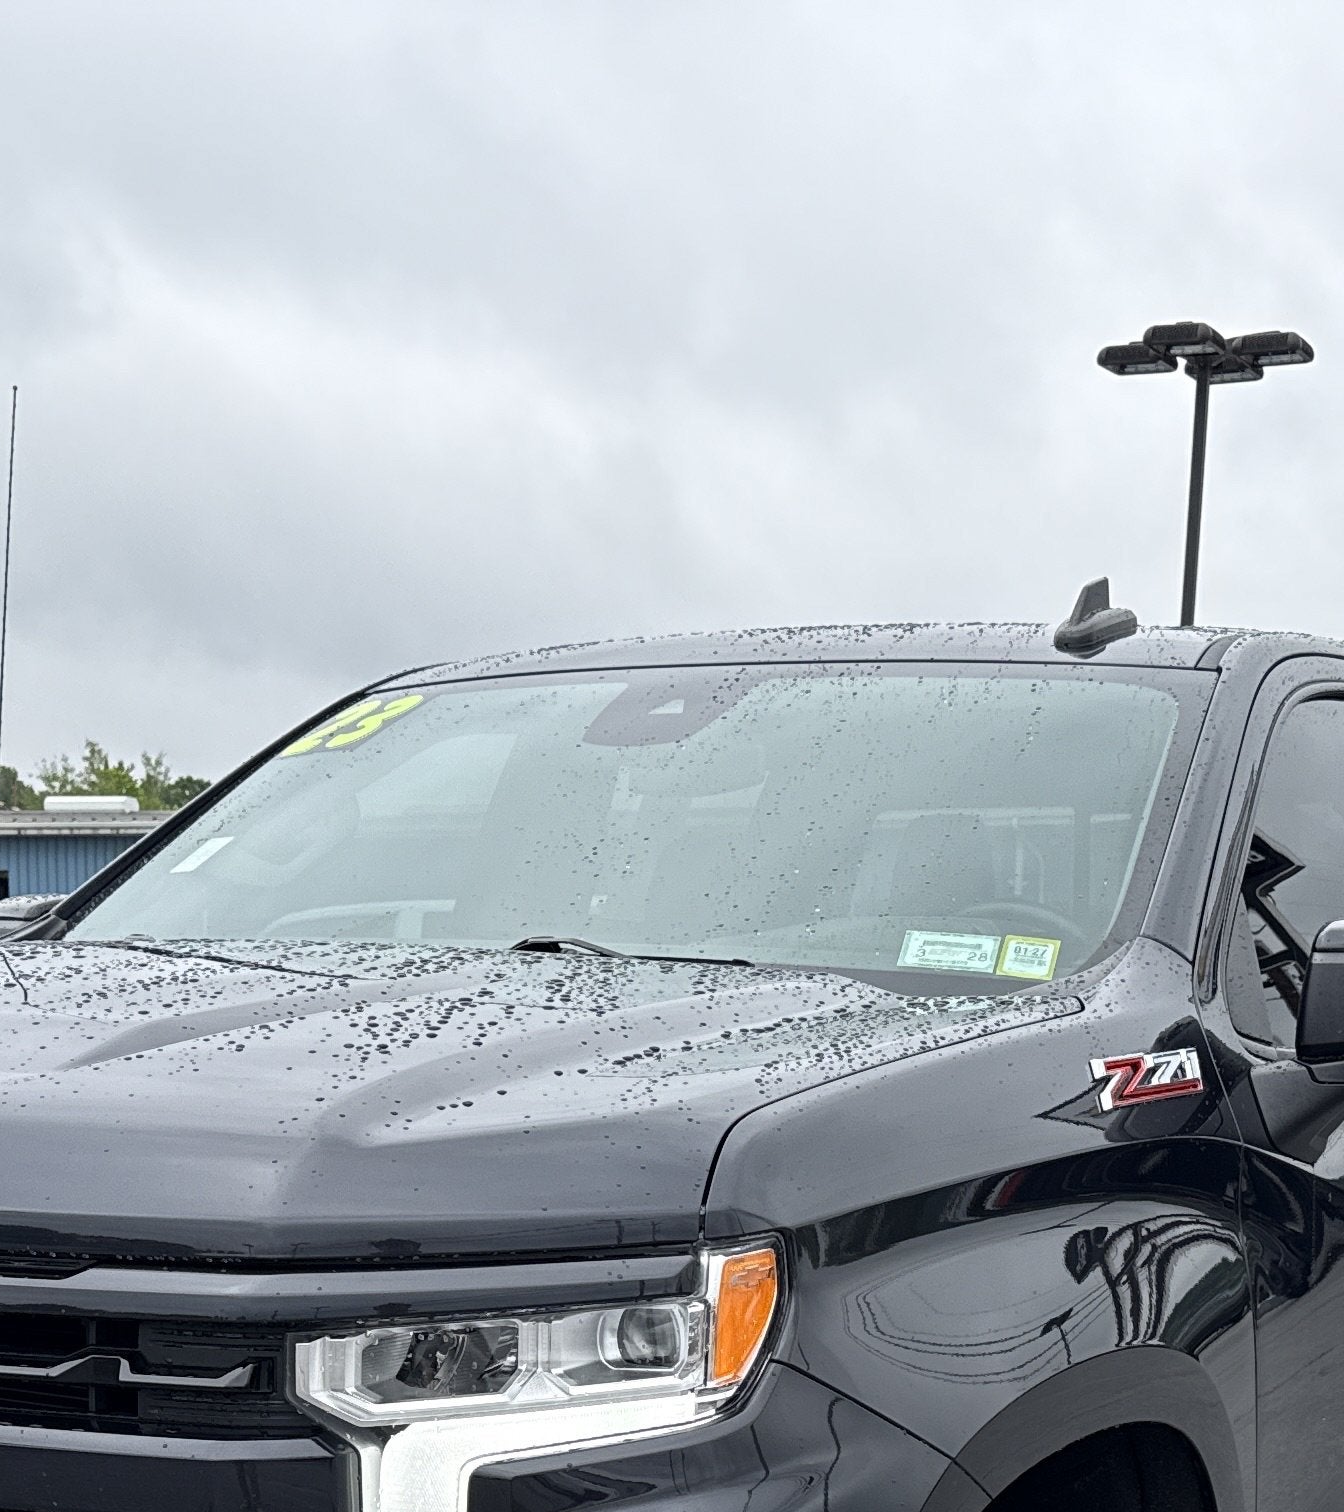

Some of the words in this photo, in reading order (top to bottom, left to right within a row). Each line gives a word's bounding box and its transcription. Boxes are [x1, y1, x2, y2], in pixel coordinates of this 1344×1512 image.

[281, 694, 424, 758] 23
[967, 951, 988, 962] 28
[1089, 1047, 1203, 1111] Z71
